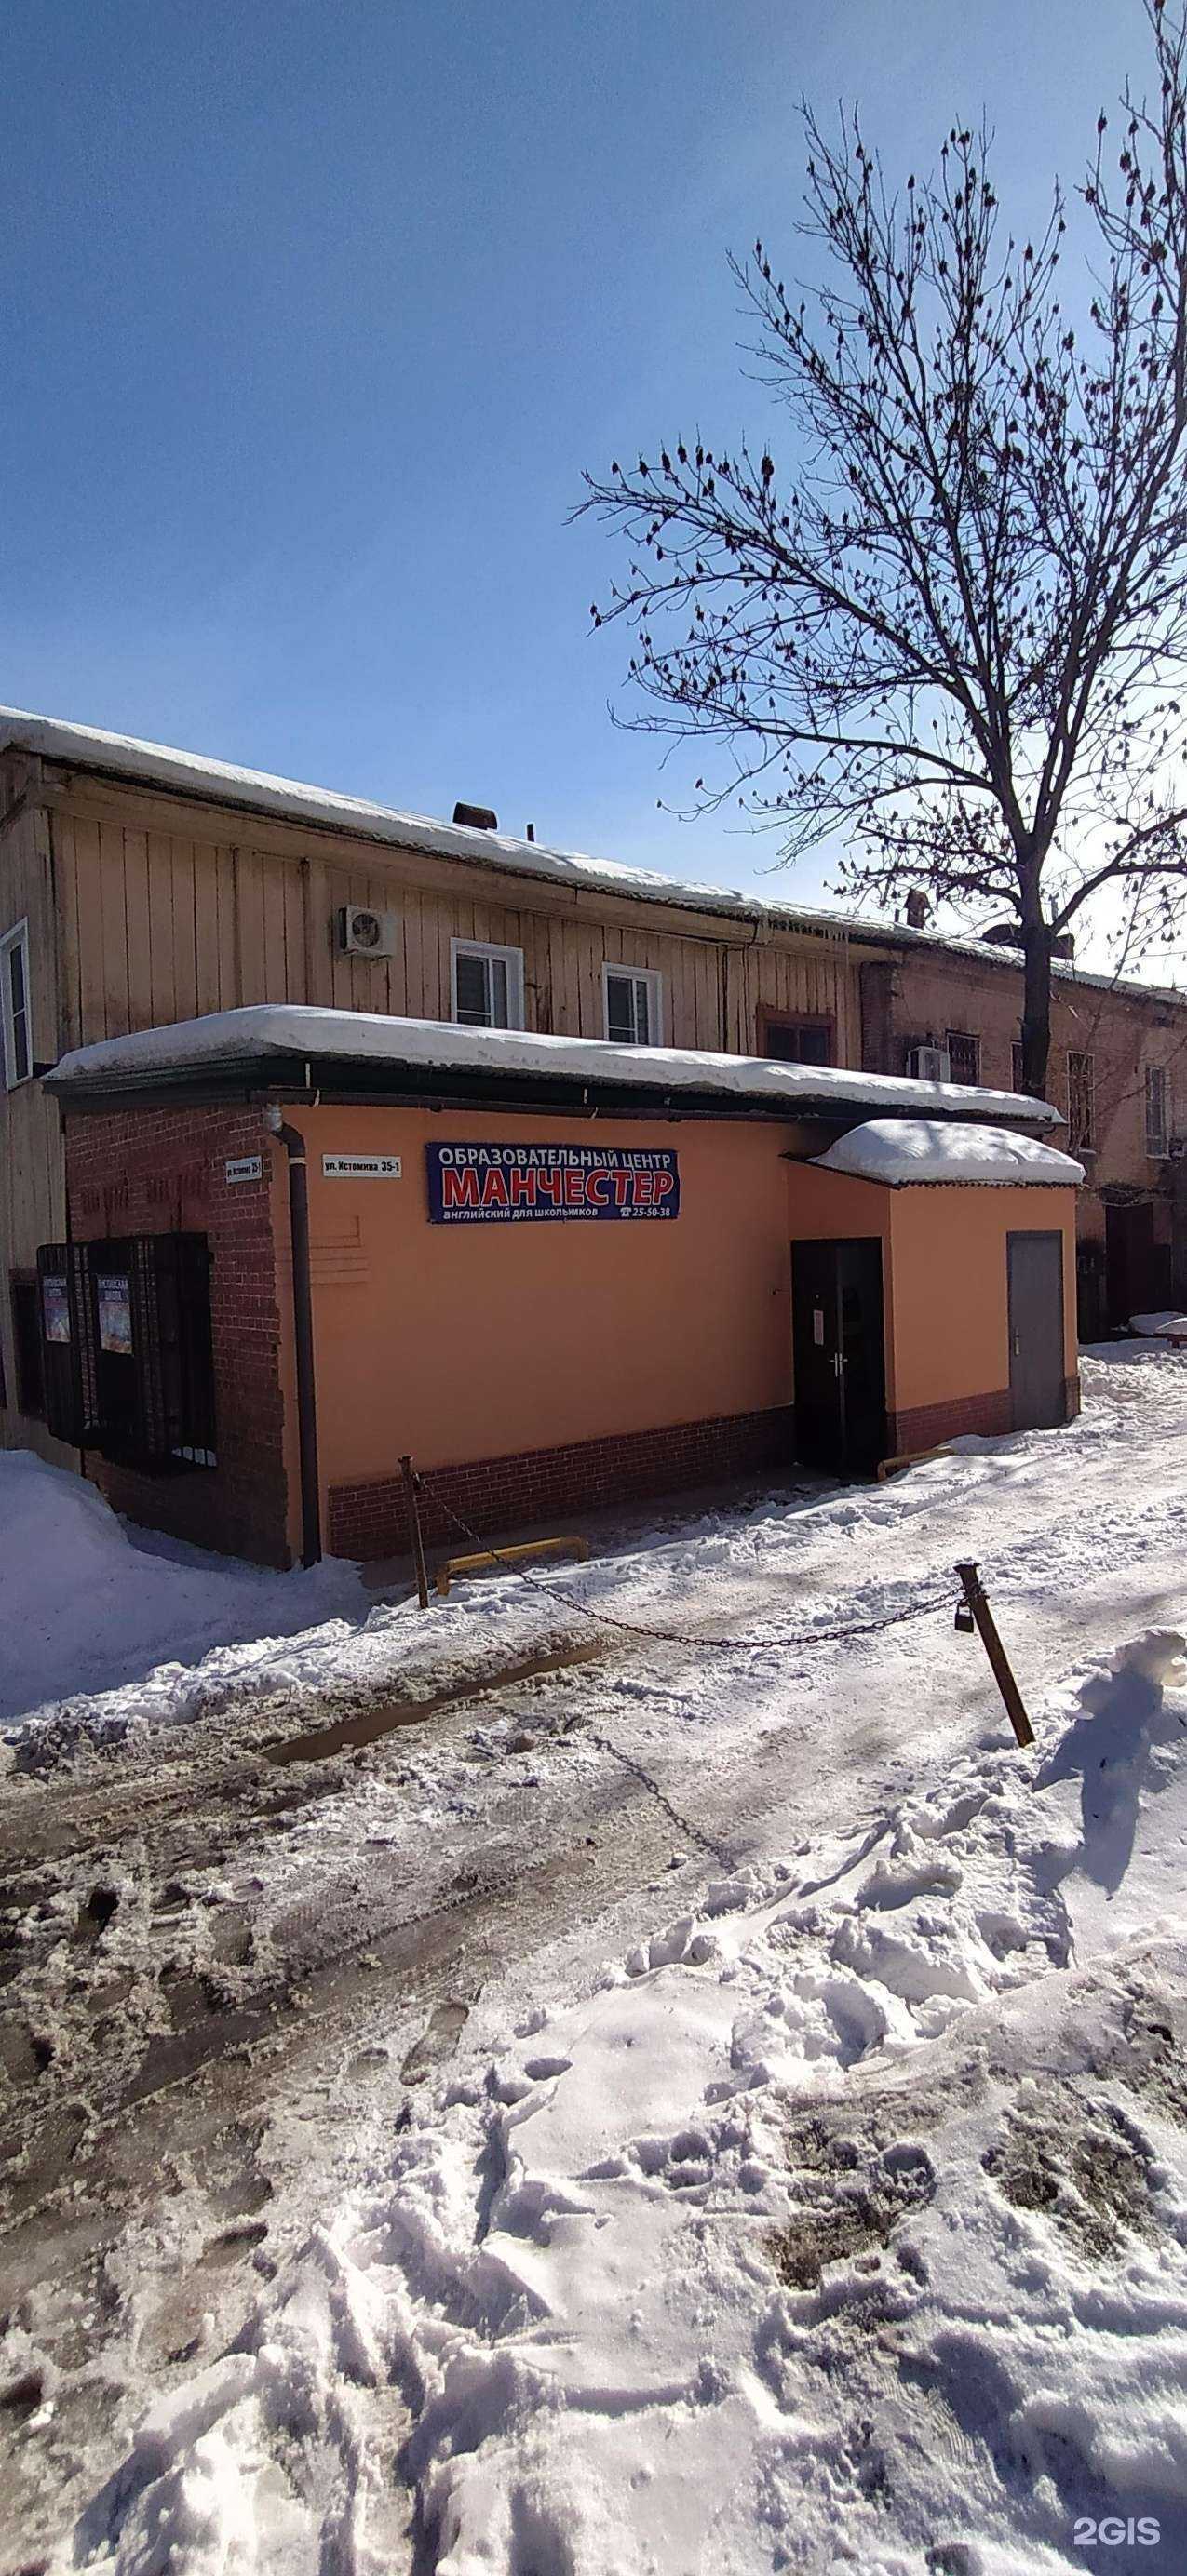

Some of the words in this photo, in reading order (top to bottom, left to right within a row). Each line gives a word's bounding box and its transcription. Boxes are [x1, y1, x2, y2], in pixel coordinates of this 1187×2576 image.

[438, 1147, 618, 1167] ОБРАЗОВАТЕЛЬНЫЙ
[622, 1152, 671, 1170] ЦЕНТР
[325, 1162, 337, 1171] ул.
[338, 1161, 378, 1171] Истомина
[381, 1161, 399, 1171] 35-1
[442, 1168, 674, 1207] МАНЧЕСТЕР
[443, 1207, 510, 1219] английский
[512, 1208, 533, 1219] для
[534, 1206, 598, 1217] школьников
[632, 1207, 670, 1217] 25-50-38
